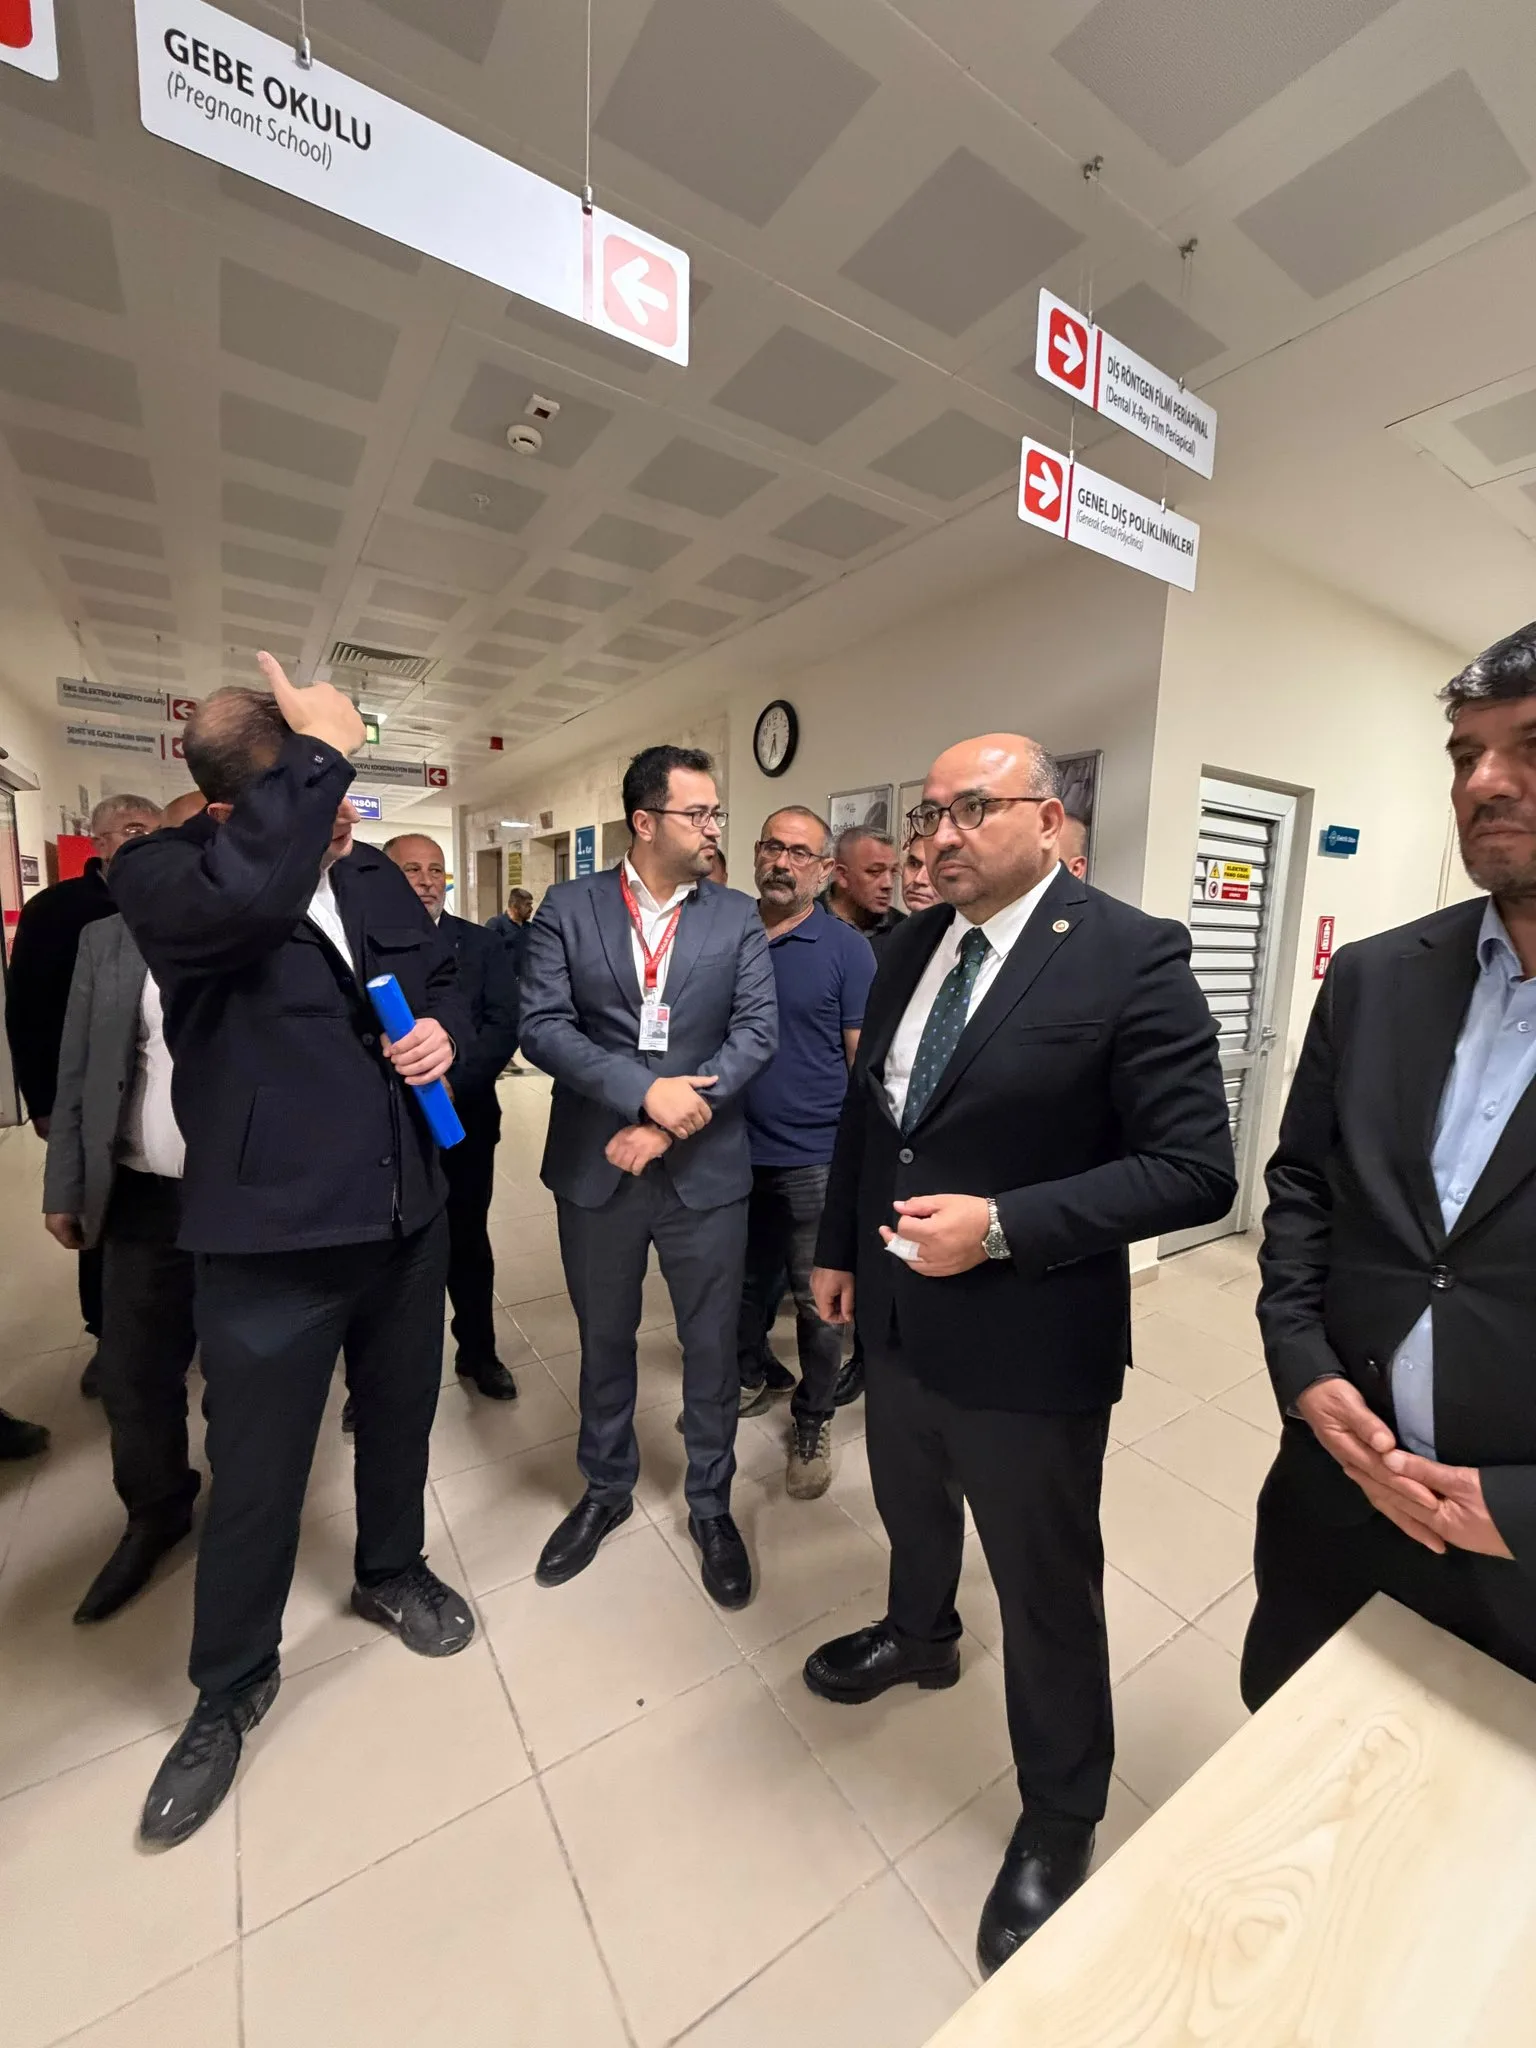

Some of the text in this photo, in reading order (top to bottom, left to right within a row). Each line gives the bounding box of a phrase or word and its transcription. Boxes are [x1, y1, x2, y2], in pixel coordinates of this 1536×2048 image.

[164, 28, 371, 150] GEBE OKULU
[167, 71, 332, 171] (Pregnant School)
[1106, 384, 1131, 414] (Dental
[1131, 401, 1151, 430] X-Ray
[1151, 414, 1164, 436] Film
[1107, 356, 1120, 383] DİŞ
[1121, 365, 1154, 402] RÖNTGEN
[1154, 388, 1173, 416] FİLMİ
[1078, 488, 1195, 557] GENEL DİŞ POLİKLİNİKLERİ
